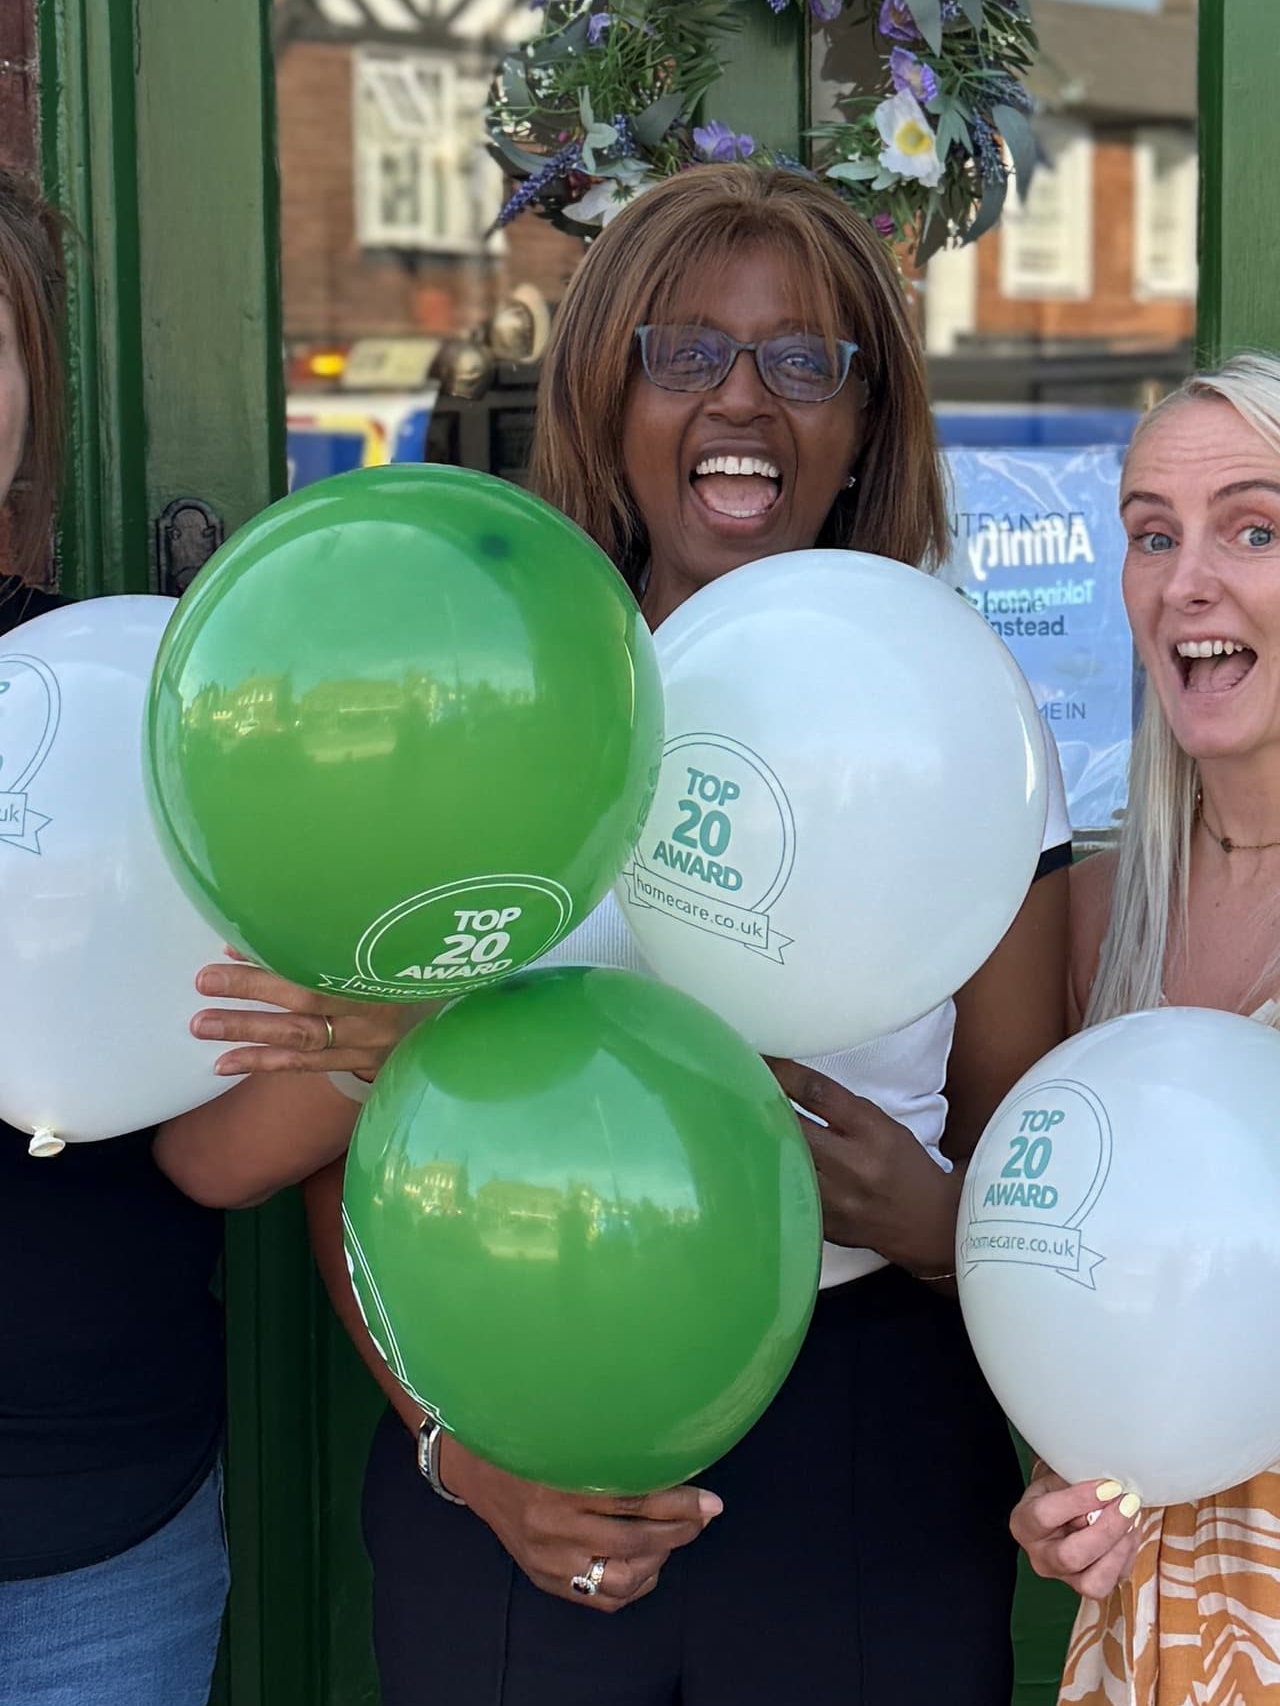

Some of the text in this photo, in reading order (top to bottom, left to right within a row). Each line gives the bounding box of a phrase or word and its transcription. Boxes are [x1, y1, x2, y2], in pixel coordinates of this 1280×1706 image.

[949, 512, 1084, 538] NTRANCE
[984, 615, 1065, 636] nstead
[687, 767, 740, 806] TOP
[672, 799, 731, 857] 20
[653, 840, 743, 891] AWARD
[454, 907, 521, 932] TOP
[637, 876, 762, 938] homecare.co.uk
[431, 932, 510, 965] 20
[395, 959, 513, 979] AWARD
[1020, 1109, 1065, 1132] TOP
[1001, 1136, 1053, 1179] 20
[983, 1183, 1058, 1209] AWARD
